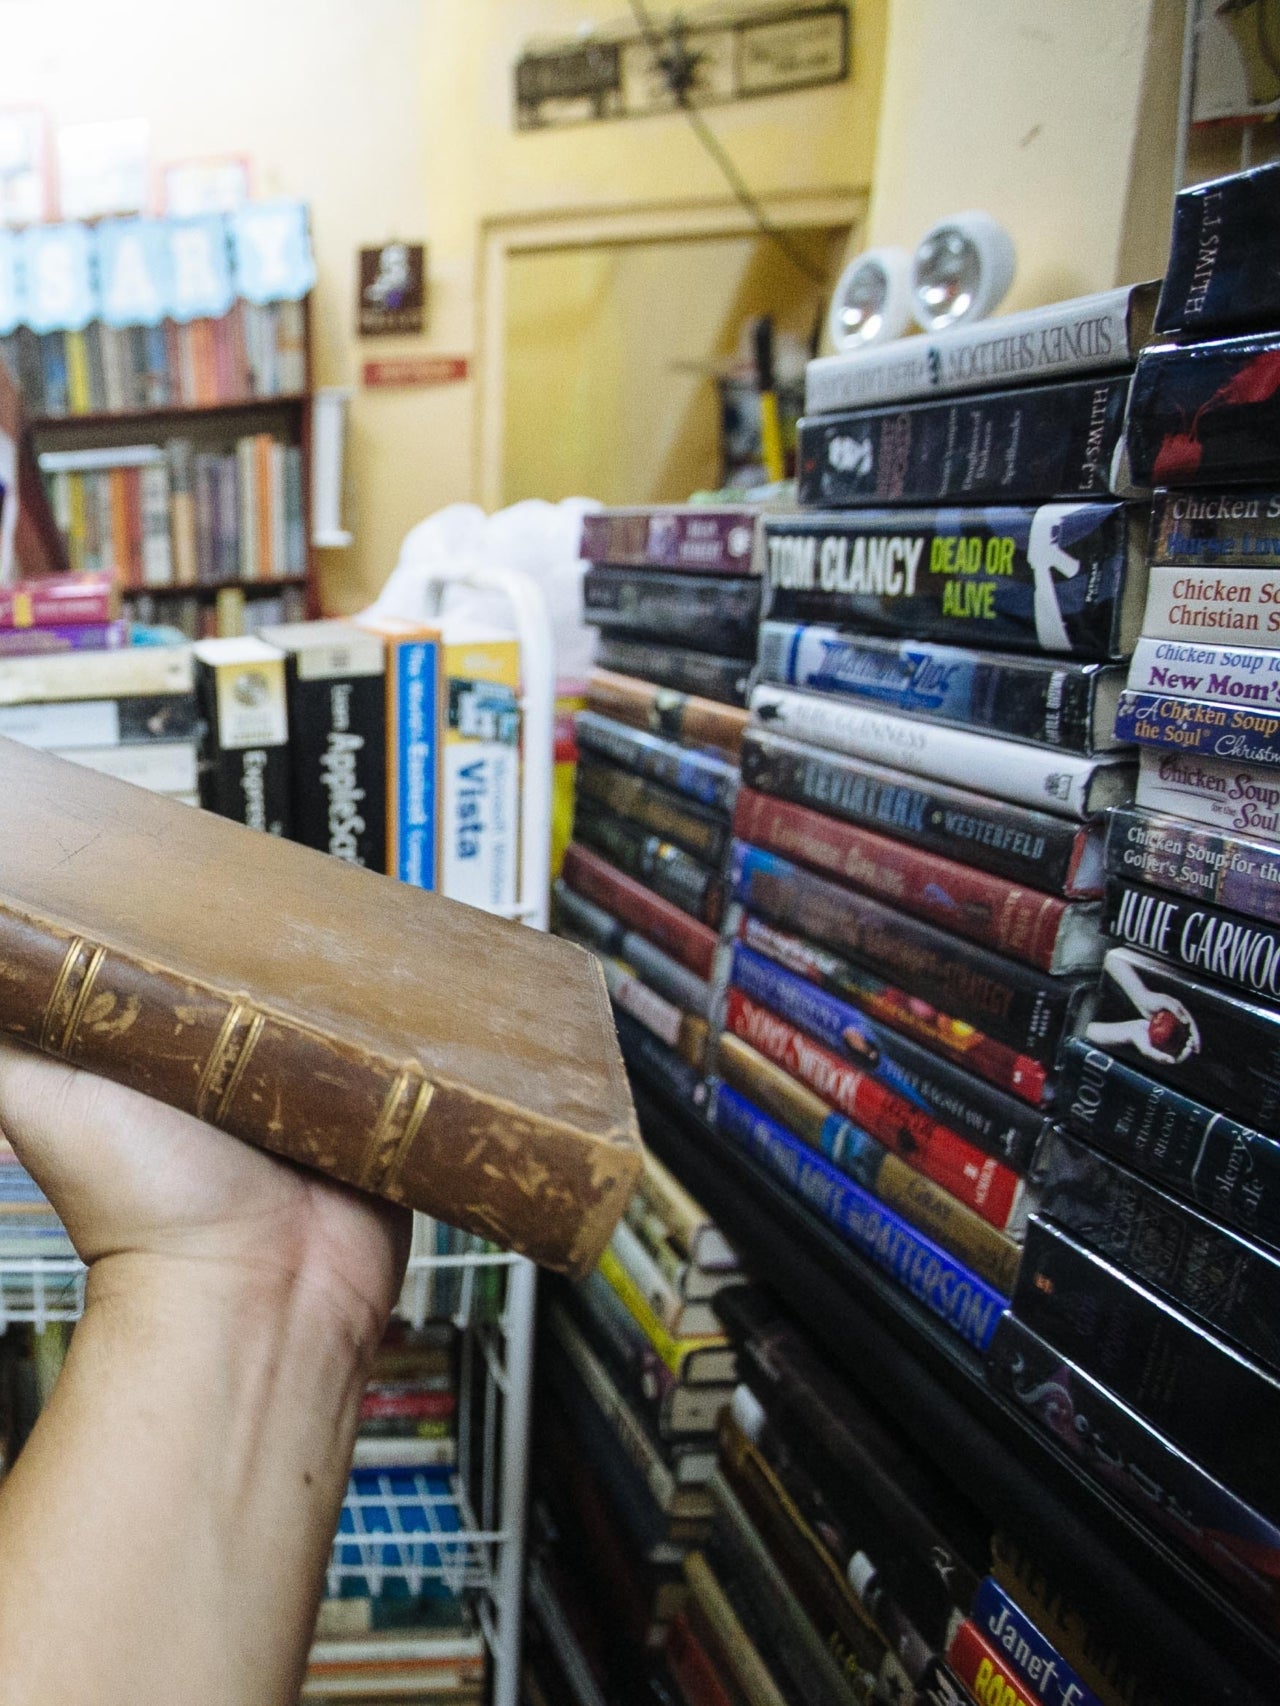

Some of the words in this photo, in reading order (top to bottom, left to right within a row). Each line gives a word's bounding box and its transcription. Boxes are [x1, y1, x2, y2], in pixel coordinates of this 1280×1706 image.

[1183, 233, 1220, 315] SMITH
[1036, 316, 1113, 364] SIDNEY
[1085, 386, 1110, 461] SMITH
[1172, 495, 1259, 520] Chicken
[769, 536, 816, 591] TOM
[820, 536, 925, 597] CLANCY
[930, 536, 984, 576] DEAD
[986, 537, 1015, 576] OR
[943, 583, 997, 620] ALIVE
[1172, 579, 1252, 603] Chicken
[1259, 583, 1280, 604] So
[1169, 605, 1259, 630] Christian
[1148, 667, 1204, 691] New
[1155, 643, 1216, 666] Chicken
[1220, 653, 1264, 674] Soup
[1135, 722, 1160, 739] the
[1164, 727, 1203, 747] Soul
[1136, 698, 1161, 720] A
[1160, 700, 1226, 727] Chicken
[1231, 711, 1279, 738] Soup
[1158, 753, 1226, 793] Chicken
[1228, 773, 1280, 811] Soup
[457, 759, 487, 861] Vista
[1233, 803, 1279, 832] Soul
[943, 811, 1046, 861] WESTERFELD
[1127, 827, 1182, 856] Chicken
[1186, 843, 1225, 871] Soup
[1230, 853, 1256, 875] for
[1124, 849, 1177, 878] Golfer's
[1180, 866, 1215, 889] Soul
[1110, 889, 1179, 955] JULIE
[1071, 1050, 1114, 1122] ROUD
[1135, 1087, 1163, 1150] STIMAEUS
[1154, 1111, 1176, 1158] RILOGY
[1216, 1128, 1257, 1200] olemy's
[1241, 1177, 1266, 1209] ate
[989, 1604, 1059, 1693] Janet
